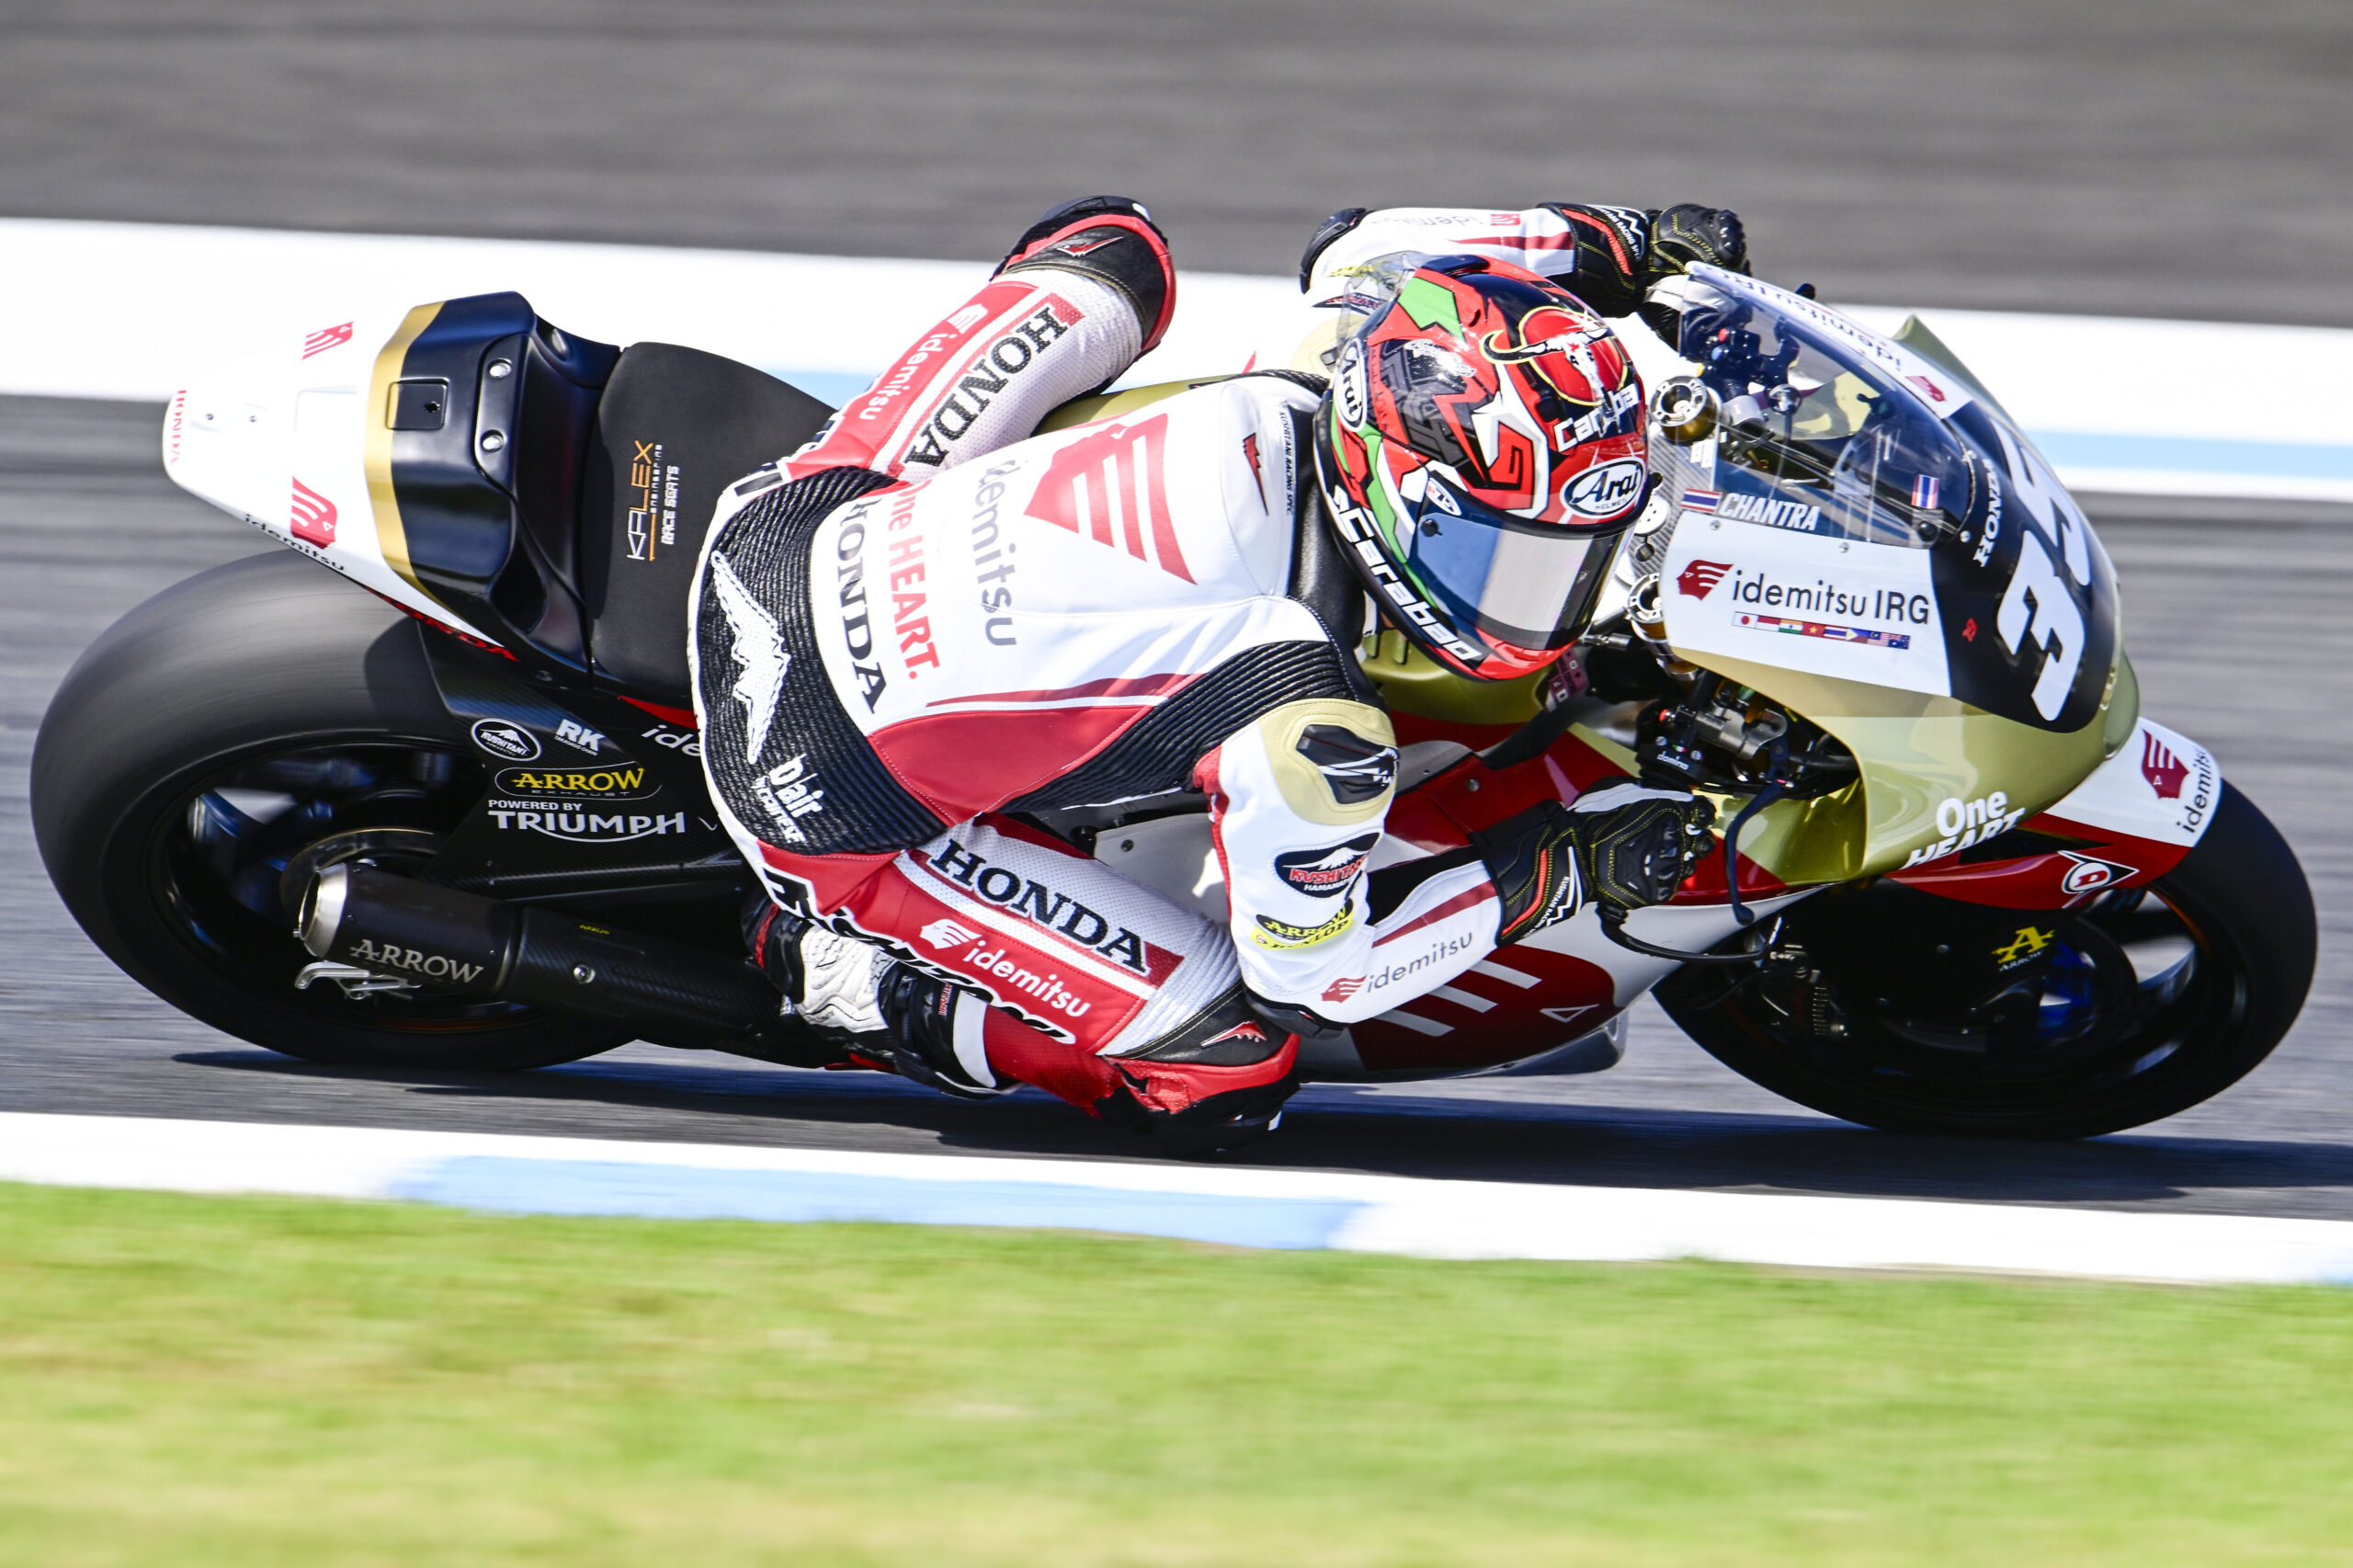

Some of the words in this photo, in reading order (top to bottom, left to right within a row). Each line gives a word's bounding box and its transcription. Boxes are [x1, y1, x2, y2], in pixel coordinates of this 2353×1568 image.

[1774, 291, 1903, 372] idemitsu
[858, 332, 957, 421] idemitsu
[904, 305, 1069, 468] HONDA
[627, 439, 654, 561] KALEX
[1569, 465, 1642, 505] Arai
[1720, 493, 1821, 531] CHANTRA
[1339, 507, 1483, 661] Carabao
[1732, 569, 1868, 617] idemitsu
[1874, 589, 1929, 625] IRG
[1989, 417, 2091, 722] 35
[835, 497, 888, 714] HONDA
[556, 719, 606, 751] RK
[1656, 750, 1689, 770] domino
[488, 800, 559, 811] POWERED
[563, 802, 583, 812] BY
[511, 767, 645, 791] ARROW
[531, 790, 631, 798] EXHAUST
[487, 811, 686, 843] TRIUMPH
[1936, 791, 2008, 837] One
[926, 838, 1151, 975] HONDA
[349, 939, 484, 983] ARROW
[962, 940, 1092, 1017] idemitsu
[1367, 932, 1473, 994] idemitsu
